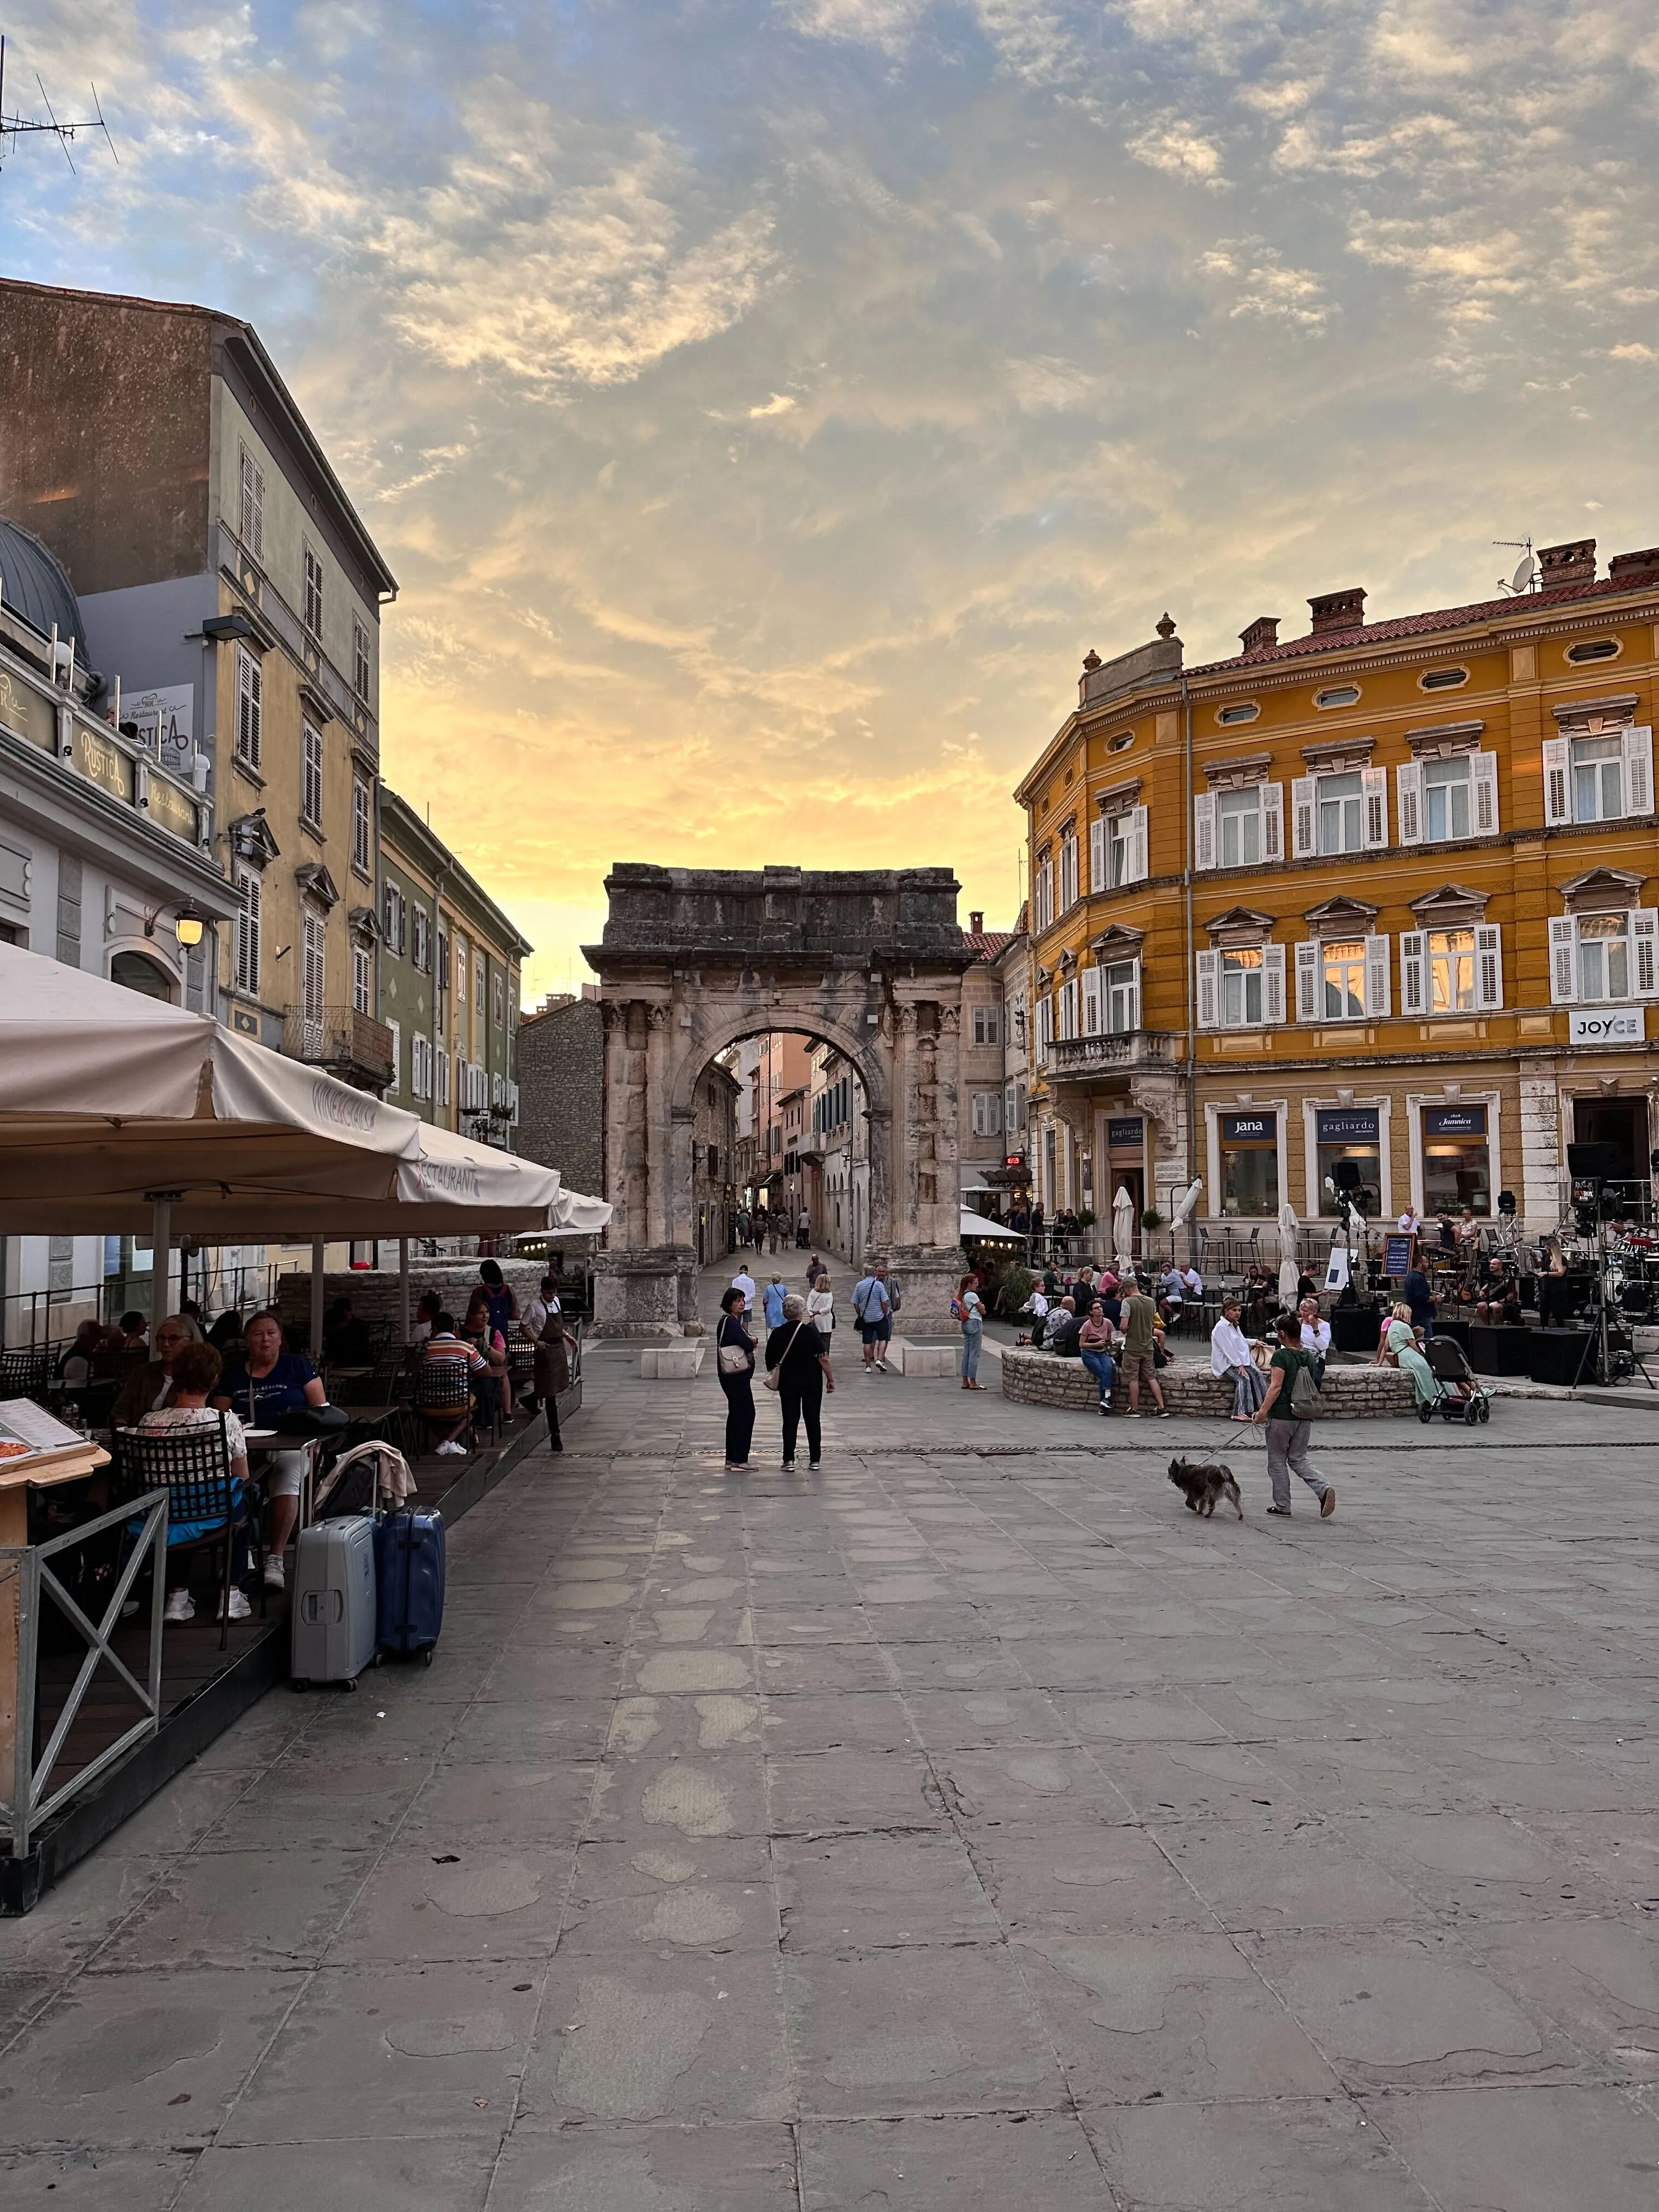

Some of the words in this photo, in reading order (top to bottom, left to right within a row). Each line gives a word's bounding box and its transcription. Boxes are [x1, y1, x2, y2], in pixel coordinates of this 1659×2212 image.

[139, 715, 189, 750] STICA
[151, 779, 193, 825] Restaurant
[1577, 1015, 1637, 1038] JOYCE
[1111, 1127, 1142, 1137] gagliardo
[1323, 1121, 1374, 1132] gagliardo
